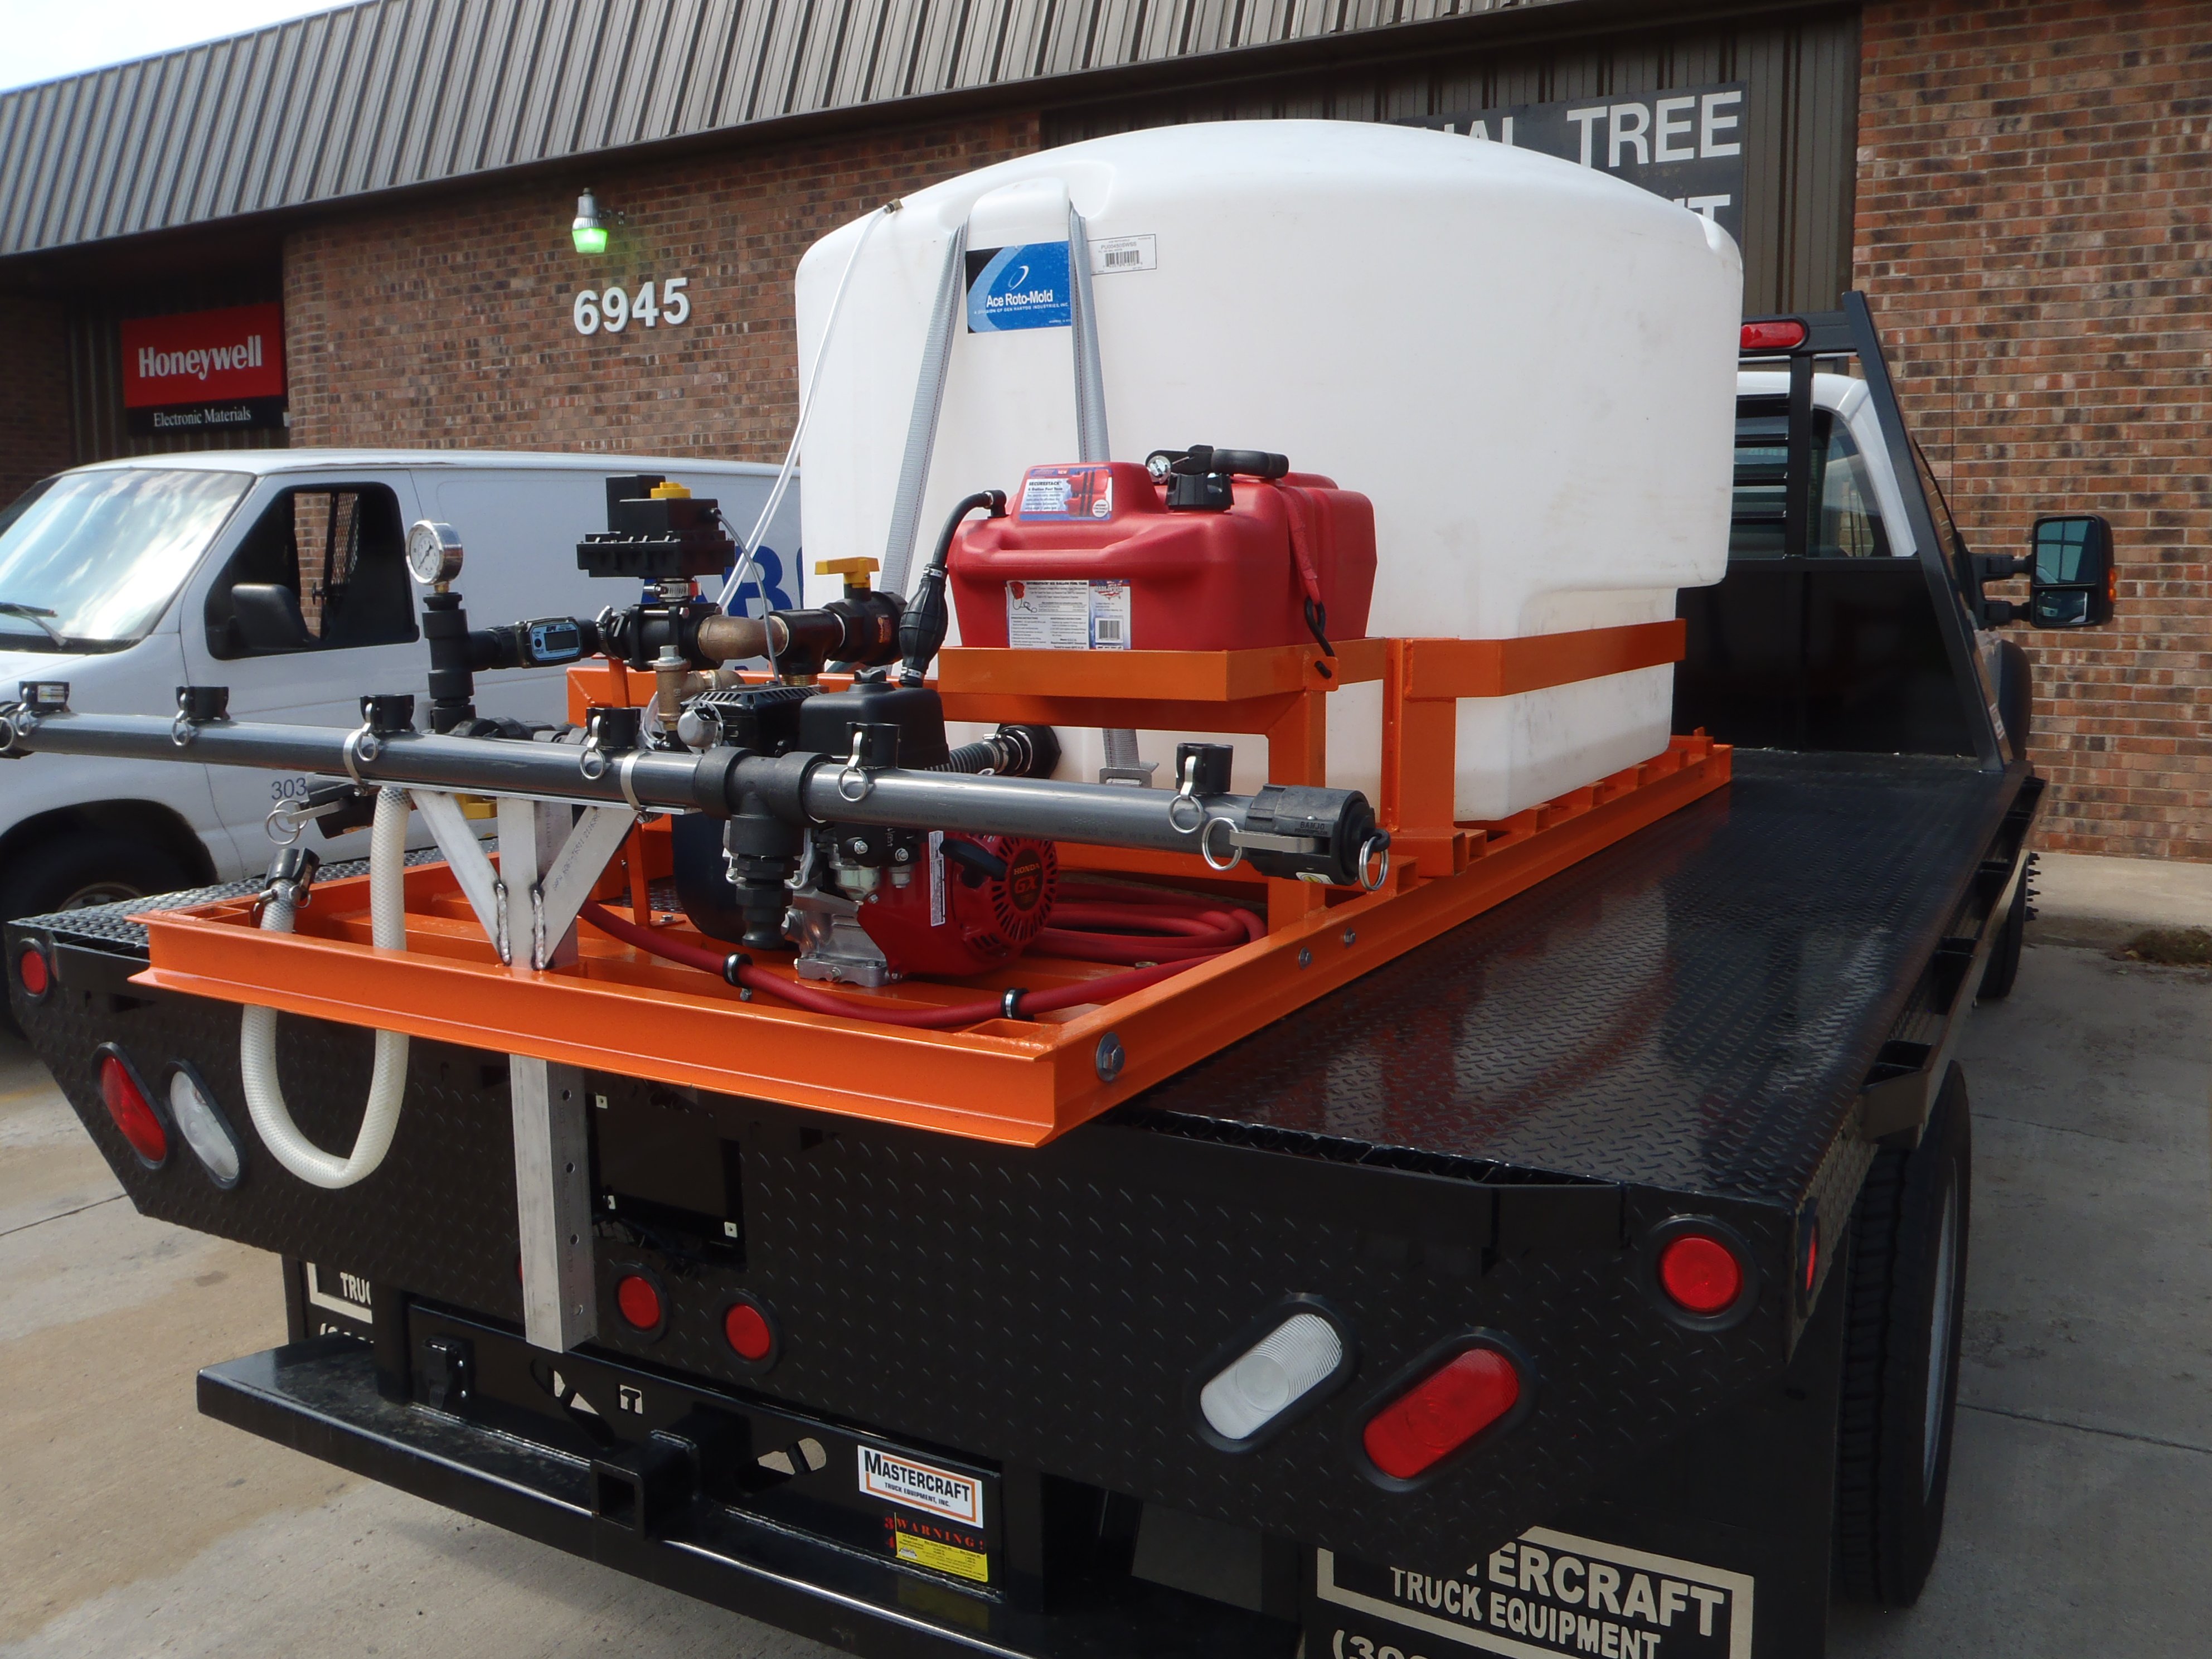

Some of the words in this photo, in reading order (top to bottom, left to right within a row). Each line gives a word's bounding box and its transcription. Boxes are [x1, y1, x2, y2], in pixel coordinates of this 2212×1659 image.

[1567, 91, 1742, 168] TREE
[574, 277, 690, 334] 6945
[986, 295, 1003, 308] Ace
[1005, 289, 1053, 306] Roto-Mold
[138, 335, 261, 380] Honeywell
[153, 410, 202, 427] Electronic
[204, 406, 251, 424] Materials
[271, 777, 307, 800] 303
[1014, 863, 1040, 875] HONDA
[1015, 874, 1039, 894] GX
[864, 1450, 970, 1502] MASTERCRAFT
[885, 1482, 902, 1493] TRUCK
[904, 1488, 937, 1504] EQUIPMENT,
[939, 1498, 950, 1507] INC.
[1467, 1542, 1725, 1637] ERCRAFT
[1390, 1566, 1483, 1621] TRUCK
[1490, 1592, 1661, 1659] EQUIPMENT
